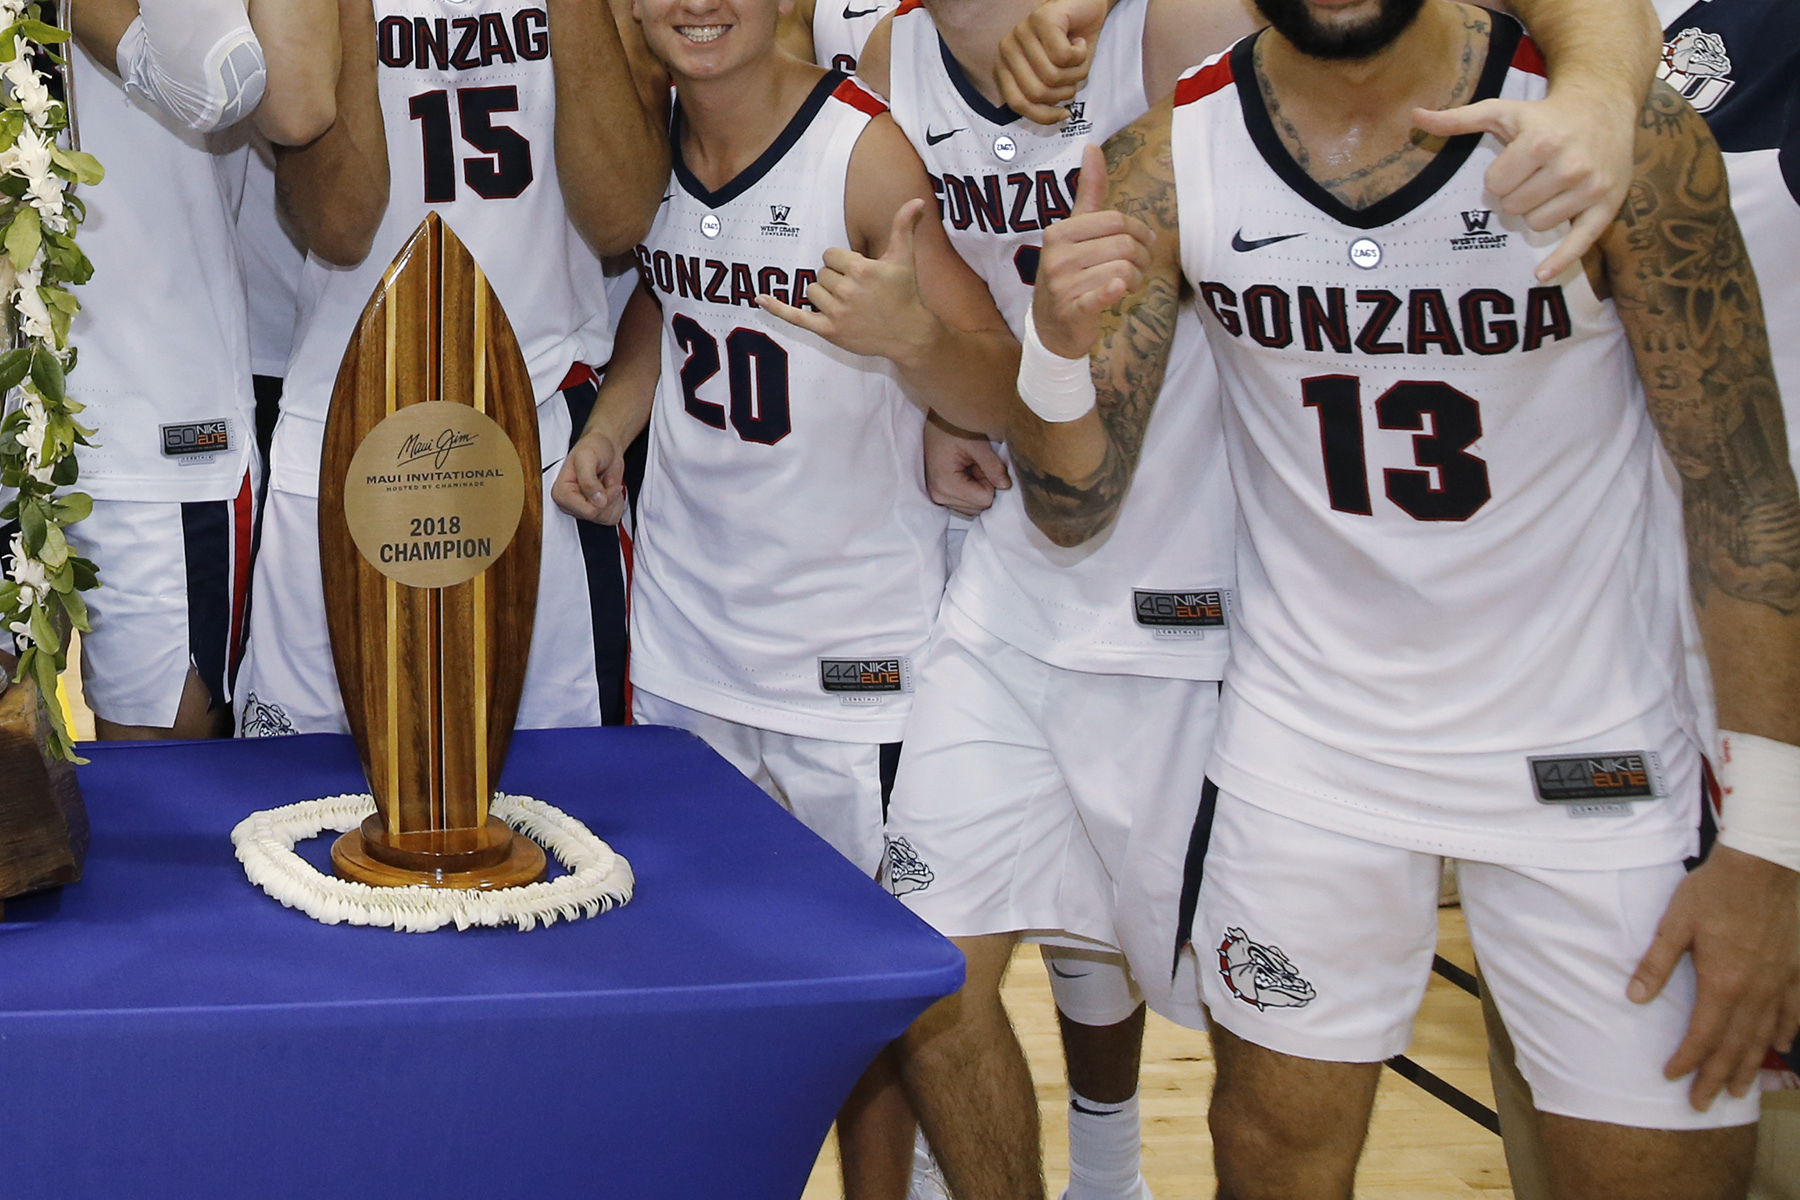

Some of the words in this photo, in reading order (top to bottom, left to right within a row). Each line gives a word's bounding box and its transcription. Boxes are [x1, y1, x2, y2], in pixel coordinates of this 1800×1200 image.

[375, 7, 552, 71] ONZAG
[408, 85, 533, 203] 15
[1450, 237, 1476, 246] WEST
[1478, 234, 1509, 244] COAST
[1353, 249, 1378, 258] ZAGS
[1199, 281, 1572, 356] GONZAGA
[672, 312, 792, 446] 20
[167, 427, 196, 446] 50
[196, 422, 226, 435] NIKE
[397, 433, 433, 459] Maui
[435, 429, 479, 469] Jim
[1301, 374, 1492, 522] 13
[366, 473, 402, 485] MAUI
[406, 468, 504, 482] INVITATIONAL
[386, 484, 419, 492] HOSTED
[435, 481, 485, 489] CHAMINADE
[410, 516, 461, 537] 2018
[380, 537, 491, 563] CHAMPION
[1139, 596, 1174, 615] 46
[1174, 593, 1219, 606] NIKE
[826, 664, 858, 681] 44
[860, 661, 898, 673] NIKE
[1543, 762, 1588, 786] 44
[1587, 757, 1643, 773] NIKE
